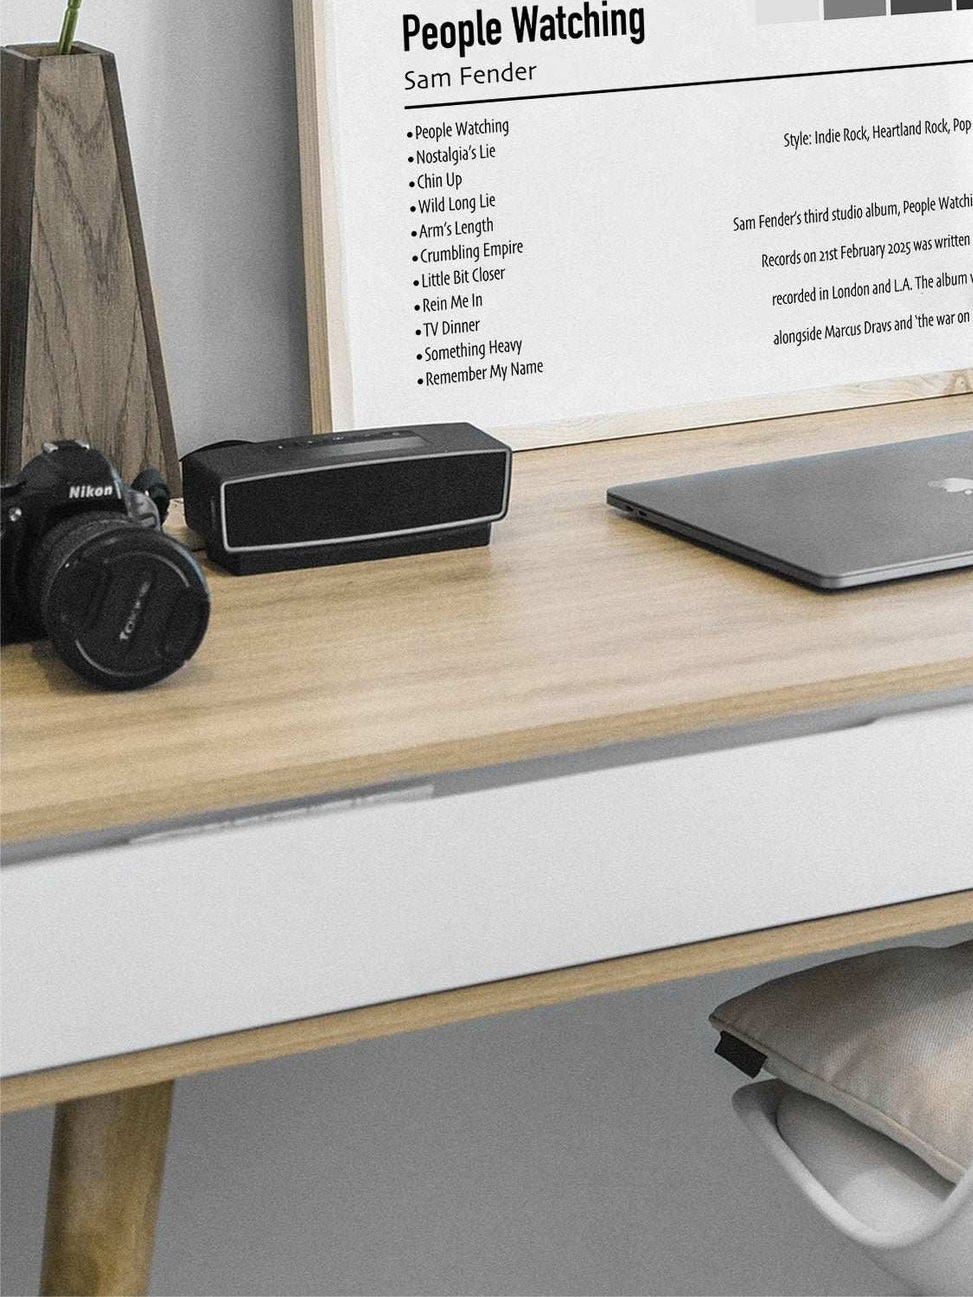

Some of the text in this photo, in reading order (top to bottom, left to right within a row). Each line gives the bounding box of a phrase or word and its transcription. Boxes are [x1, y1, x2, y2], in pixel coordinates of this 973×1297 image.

[403, 0, 645, 58] People Watching
[404, 61, 538, 91] Sam Fender
[415, 118, 510, 143] People Watching
[783, 130, 812, 151] Style:
[814, 128, 841, 145] Indie
[843, 125, 871, 143] Rock,
[872, 119, 922, 140] Heartland
[924, 117, 951, 135] Rock,
[952, 117, 972, 135] Pop
[479, 143, 496, 160] Lie
[416, 171, 463, 191] Chin Up
[417, 192, 496, 214] Wild Long Lie
[732, 216, 756, 232] Sam
[803, 206, 830, 225] third
[831, 204, 864, 222] studio
[865, 201, 901, 218] album,
[902, 196, 937, 217] People
[454, 216, 494, 238] Length
[420, 239, 524, 264] Crumbling Empire
[761, 249, 802, 268] Records
[803, 251, 817, 264] on
[818, 247, 839, 262] 21st
[840, 243, 886, 260] February
[887, 241, 912, 256] 2025
[912, 238, 933, 252] was
[933, 234, 971, 250] written
[421, 266, 506, 289] Little Bit Closer
[772, 286, 817, 307] recorded
[818, 286, 830, 301] in
[831, 281, 870, 300] London
[871, 277, 892, 295] and
[894, 277, 913, 293] L.A.
[914, 274, 934, 290] The
[935, 272, 968, 288] album
[422, 292, 483, 313] Rein Me In
[422, 319, 481, 338] TV Dinner
[773, 325, 823, 347] alongside
[824, 324, 862, 340] Marcus
[863, 320, 893, 335] Dravs
[893, 314, 913, 332] and
[935, 313, 956, 326] war
[957, 311, 970, 324] on
[424, 339, 523, 362] Something Heavy
[425, 361, 544, 387] Remember My Name
[69, 485, 113, 499] Nikon
